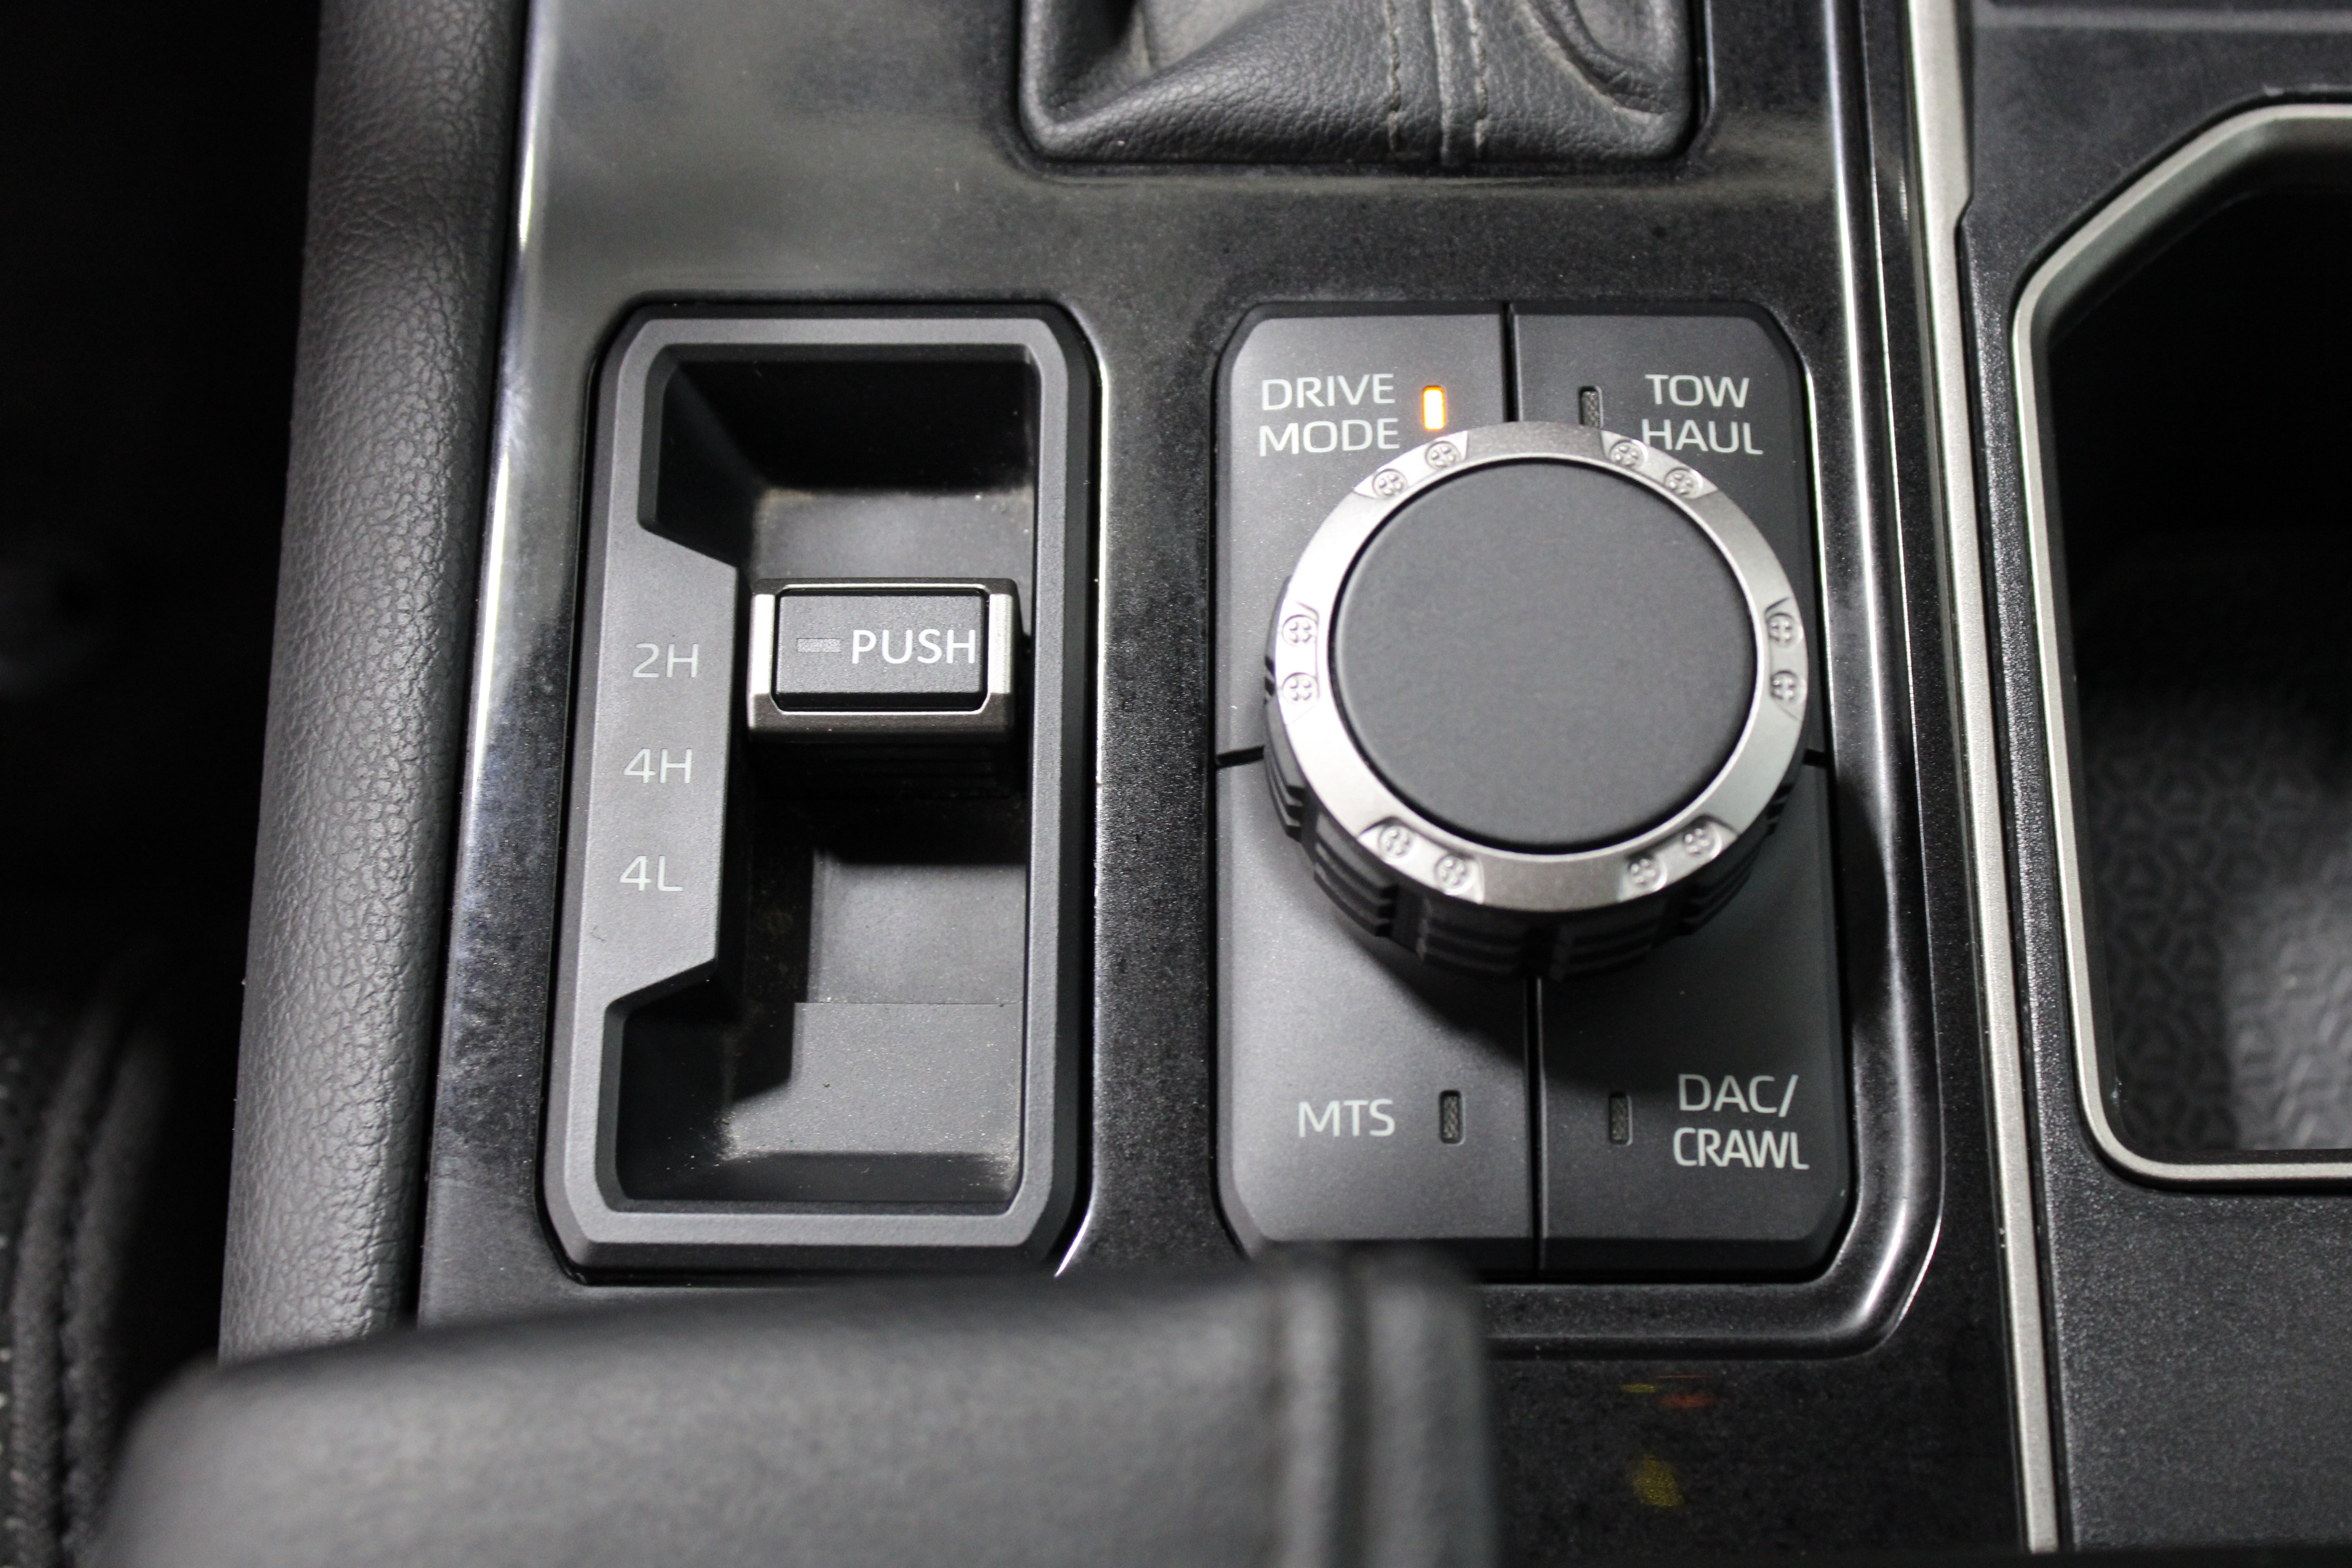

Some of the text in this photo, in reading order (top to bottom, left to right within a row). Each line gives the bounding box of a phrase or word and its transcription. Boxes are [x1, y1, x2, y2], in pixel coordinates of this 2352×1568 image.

[1262, 373, 1394, 411] DRIVE
[1645, 374, 1749, 408] TOW
[1259, 417, 1400, 457] MODE
[1641, 419, 1764, 456] HAUL
[632, 642, 699, 678] 2H
[851, 629, 976, 664] PUSH
[623, 748, 693, 784] 4H
[619, 855, 684, 891] 4L
[1677, 1074, 1799, 1117] DAC/
[1298, 1098, 1396, 1138] MTS
[1673, 1127, 1810, 1170] CRAWL
